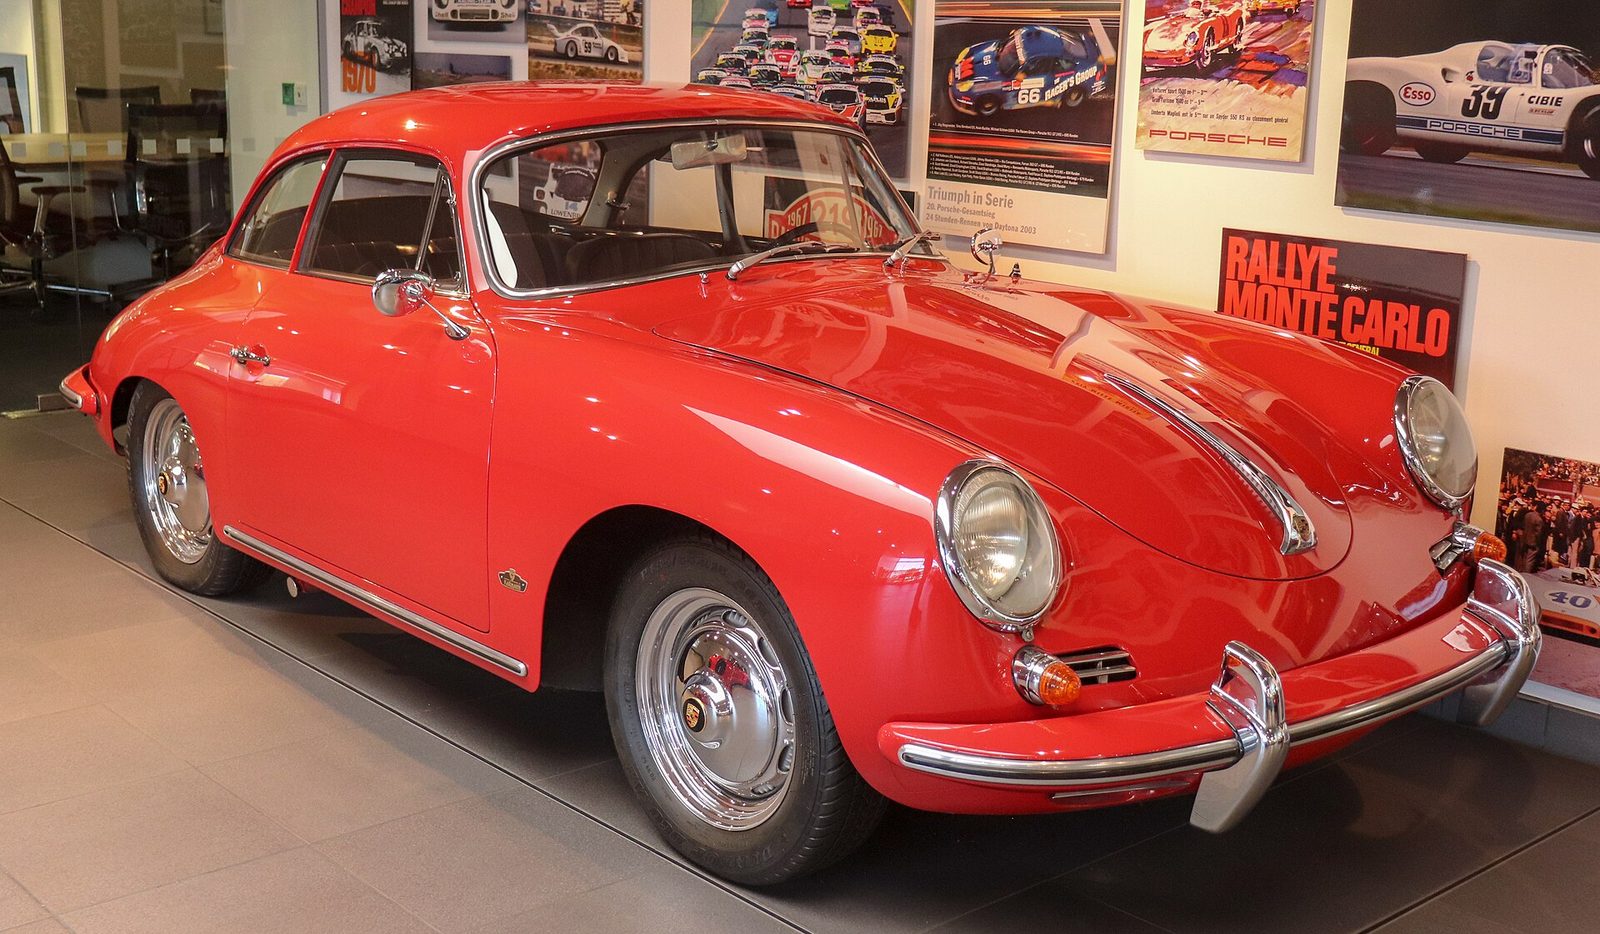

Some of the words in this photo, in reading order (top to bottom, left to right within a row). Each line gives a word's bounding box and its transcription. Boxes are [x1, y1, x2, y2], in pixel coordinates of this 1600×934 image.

[584, 42, 592, 54] 59
[1018, 88, 1040, 104] 66
[1402, 86, 1432, 101] Esso
[1461, 84, 1512, 120] 39
[1527, 95, 1564, 107] CIBIE
[1149, 129, 1288, 147] PORSCHE
[1429, 120, 1521, 139] PORSCHE
[928, 186, 971, 205] Triumph
[973, 191, 983, 205] in
[986, 192, 1014, 209] Serie
[787, 202, 809, 228] 1967
[926, 202, 936, 211] 20.
[937, 204, 996, 219] Porsche-Gesamtsieg
[863, 210, 883, 239] 1967
[926, 213, 934, 221] 24
[935, 213, 981, 227] Stunden-Rennen
[982, 222, 994, 230] von
[994, 222, 1019, 232] Daytona
[1020, 225, 1037, 235] 2003
[1226, 236, 1338, 293] RALLYE
[1223, 279, 1339, 340] MONTE
[1341, 296, 1451, 358] CARLO
[1549, 591, 1592, 609] 40
